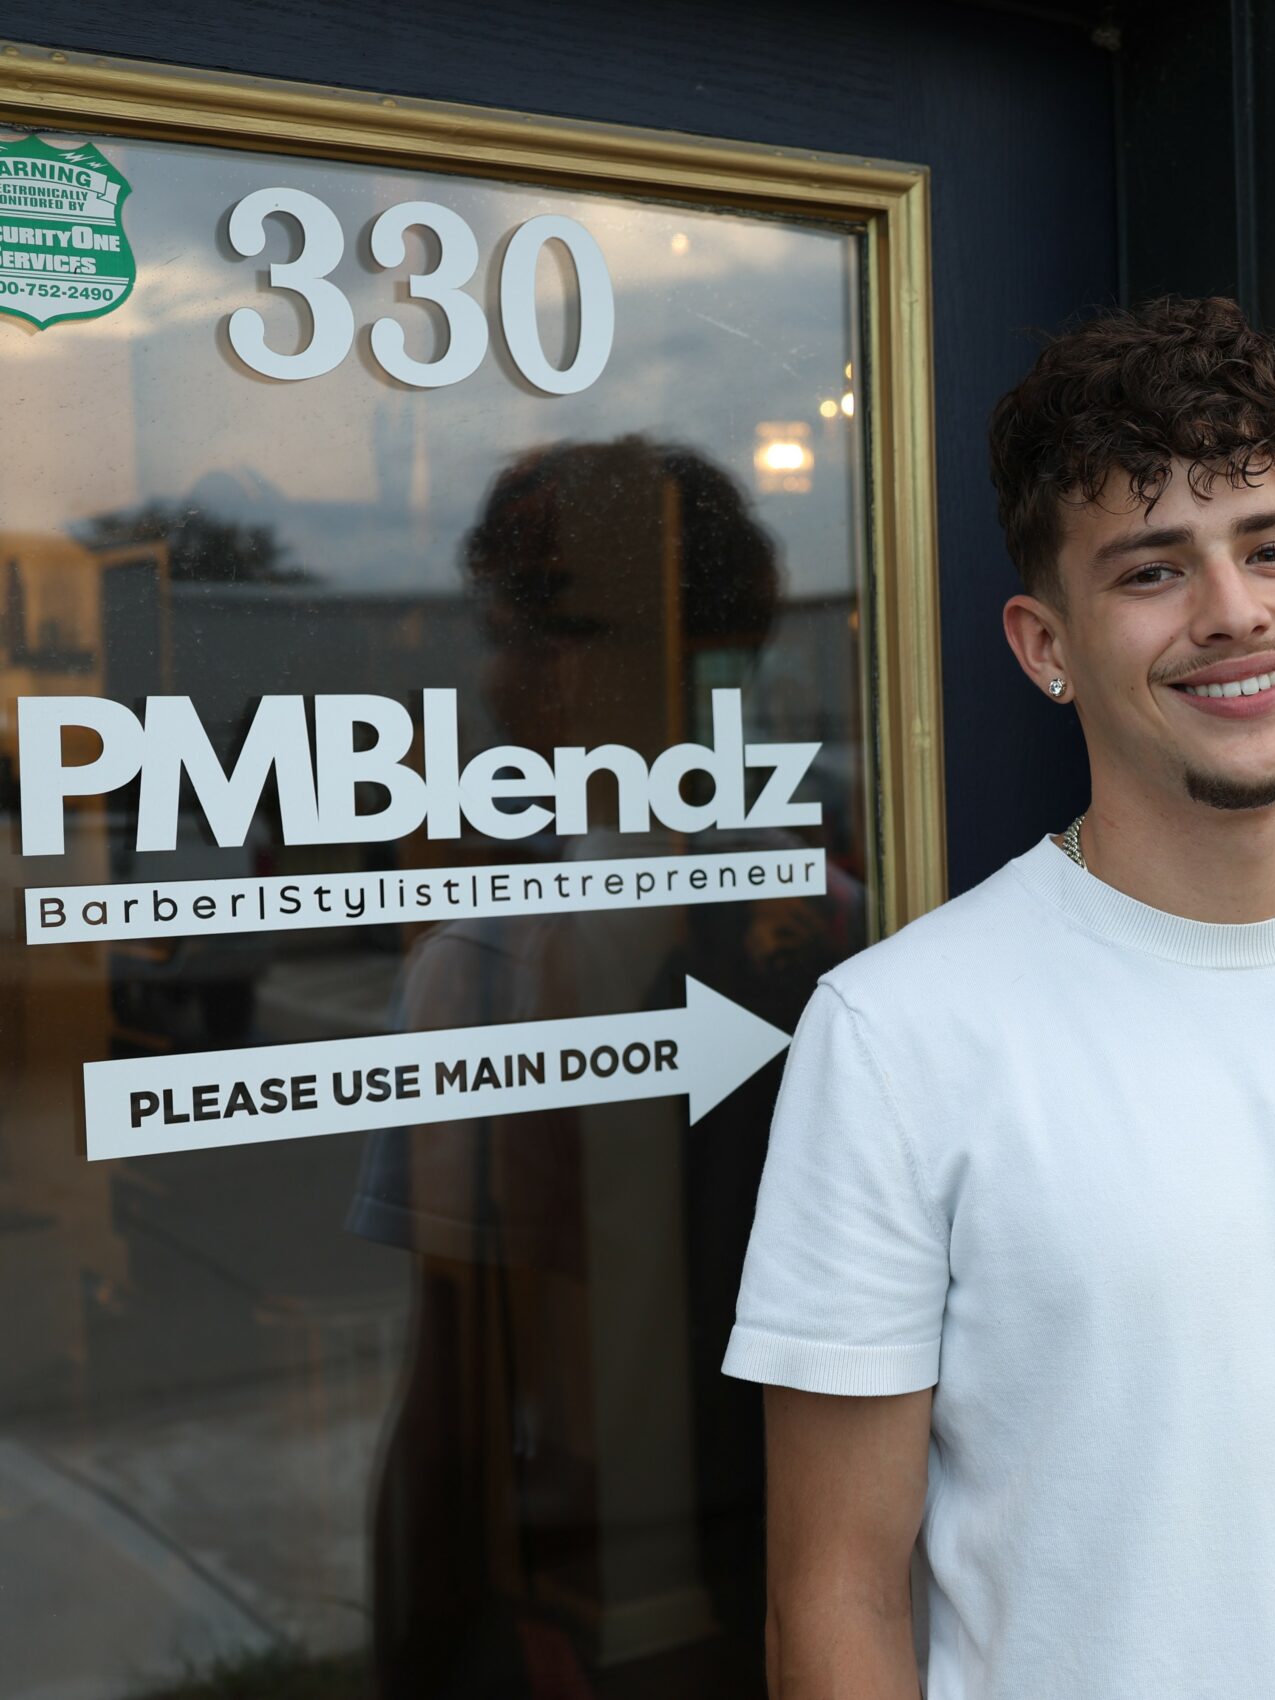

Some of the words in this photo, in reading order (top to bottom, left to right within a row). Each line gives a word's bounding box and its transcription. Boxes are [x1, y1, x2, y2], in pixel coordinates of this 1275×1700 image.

[68, 200, 85, 212] BY
[229, 187, 615, 395] 330
[17, 688, 823, 856] PMBlendz
[129, 1074, 318, 1129] PLEASE
[332, 1064, 421, 1106] USE
[434, 1051, 547, 1095] MAIN
[560, 1039, 680, 1082] DOOR
